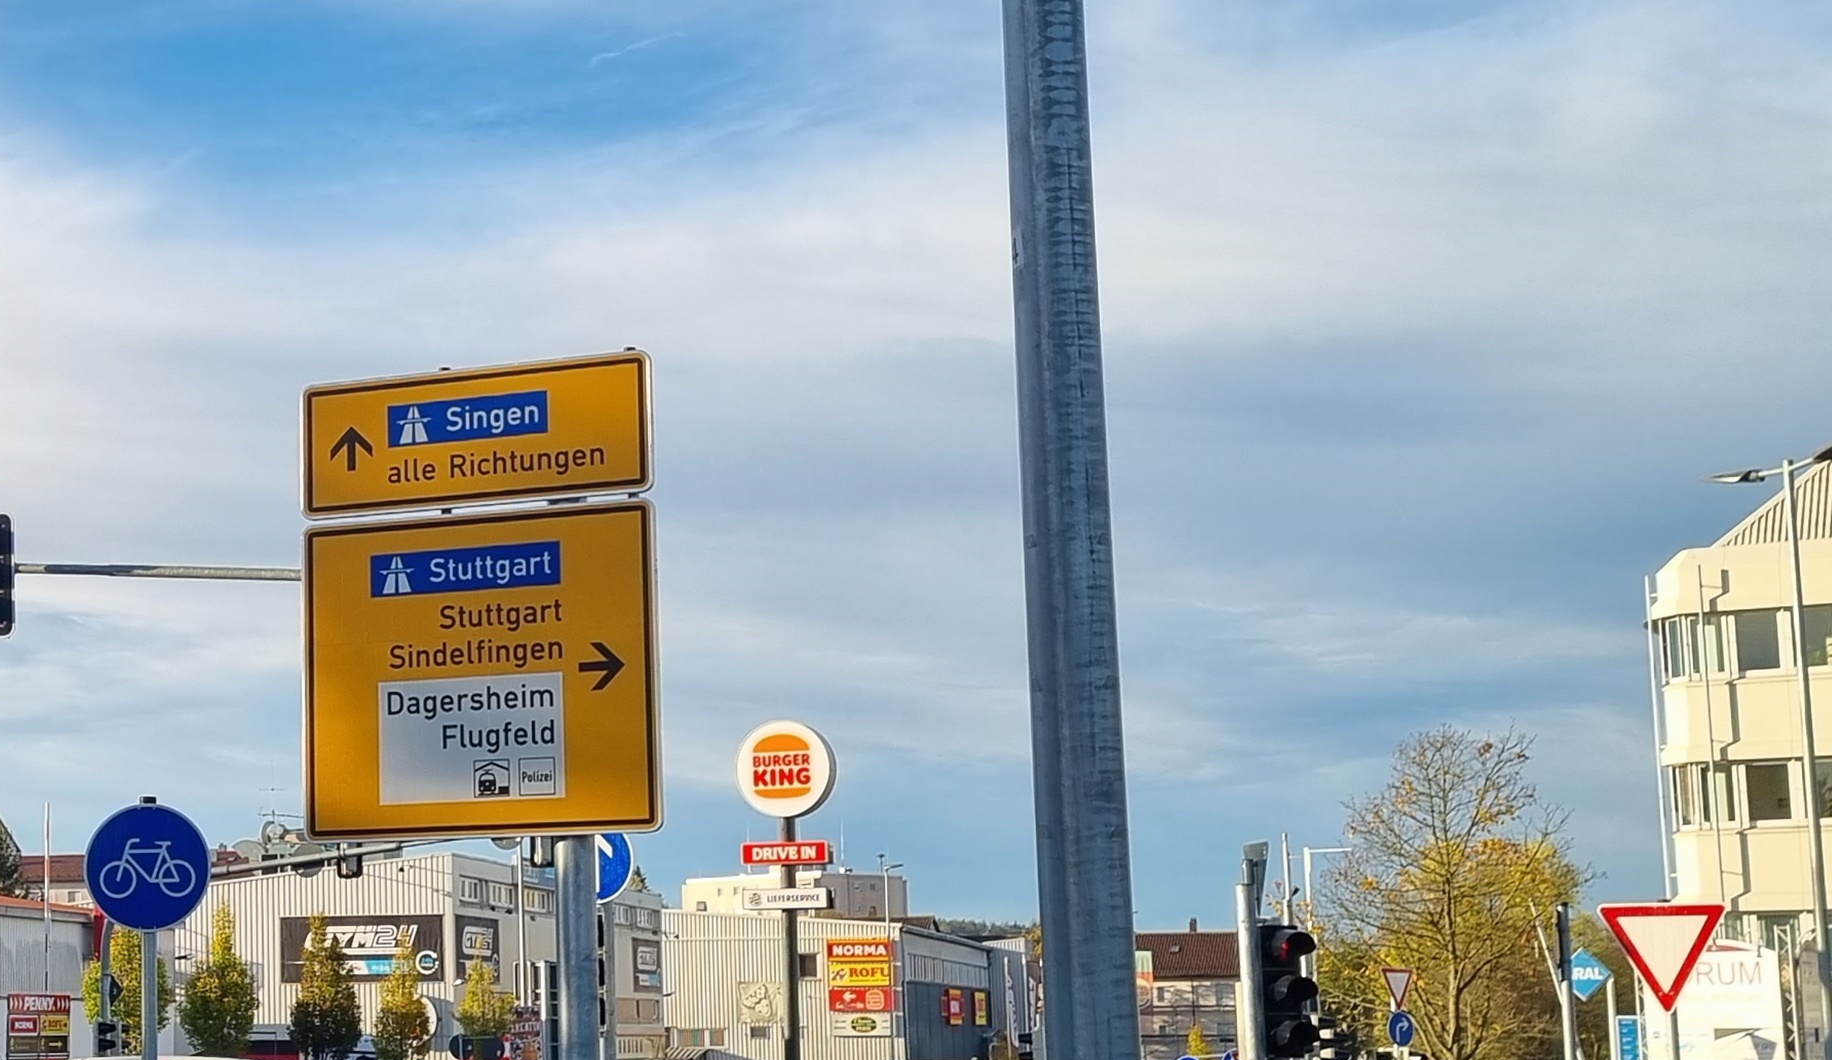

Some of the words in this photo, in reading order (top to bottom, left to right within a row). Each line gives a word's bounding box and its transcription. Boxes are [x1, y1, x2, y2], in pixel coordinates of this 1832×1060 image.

[445, 403, 540, 434] Singen
[387, 457, 437, 484] alle
[449, 446, 606, 479] Richtungen
[428, 551, 552, 585] Stuttgart
[438, 599, 563, 632] Stuttgart
[388, 639, 564, 671] Sindelfingen
[386, 684, 555, 720] Dagersheim
[441, 720, 556, 754] Flugfeld
[752, 753, 810, 768] BURGER
[521, 769, 554, 784] Polizei
[753, 767, 811, 787] KING
[751, 846, 799, 861] DRIVE
[800, 845, 817, 860] IN
[766, 893, 821, 904] LIEFERSERVICE
[831, 944, 887, 957] NORMA
[848, 967, 889, 979] ROFU
[1572, 966, 1604, 981] RAL
[1687, 961, 1762, 986] RUM
